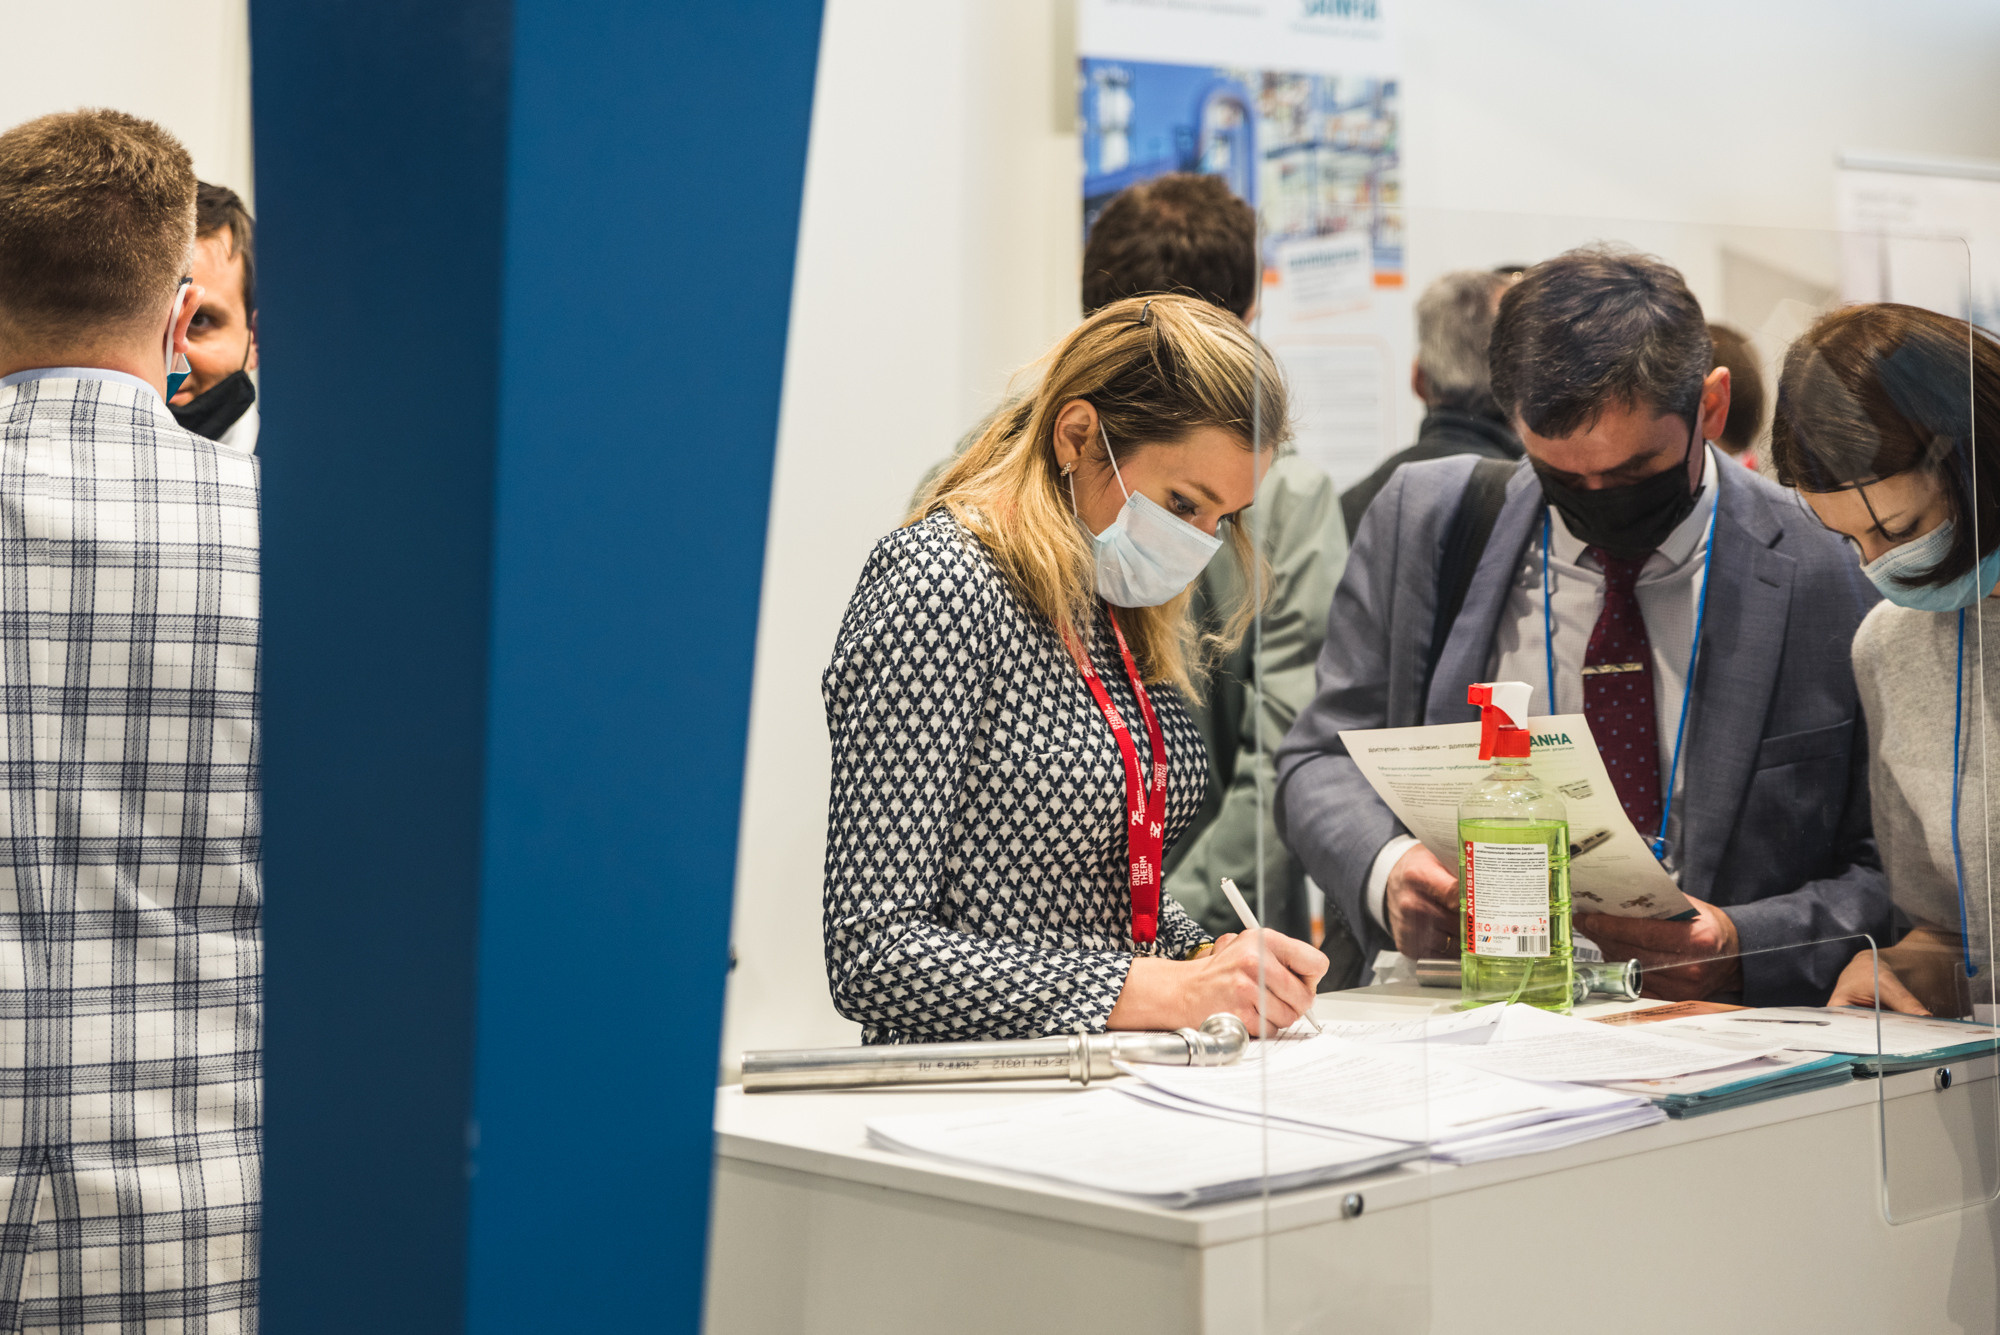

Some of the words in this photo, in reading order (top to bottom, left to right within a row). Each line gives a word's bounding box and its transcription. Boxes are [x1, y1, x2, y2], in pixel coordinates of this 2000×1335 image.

[1530, 733, 1573, 747] ANHA
[1131, 863, 1141, 886] aqua
[1139, 855, 1148, 885] THERM
[992, 1059, 1026, 1069] 10312
